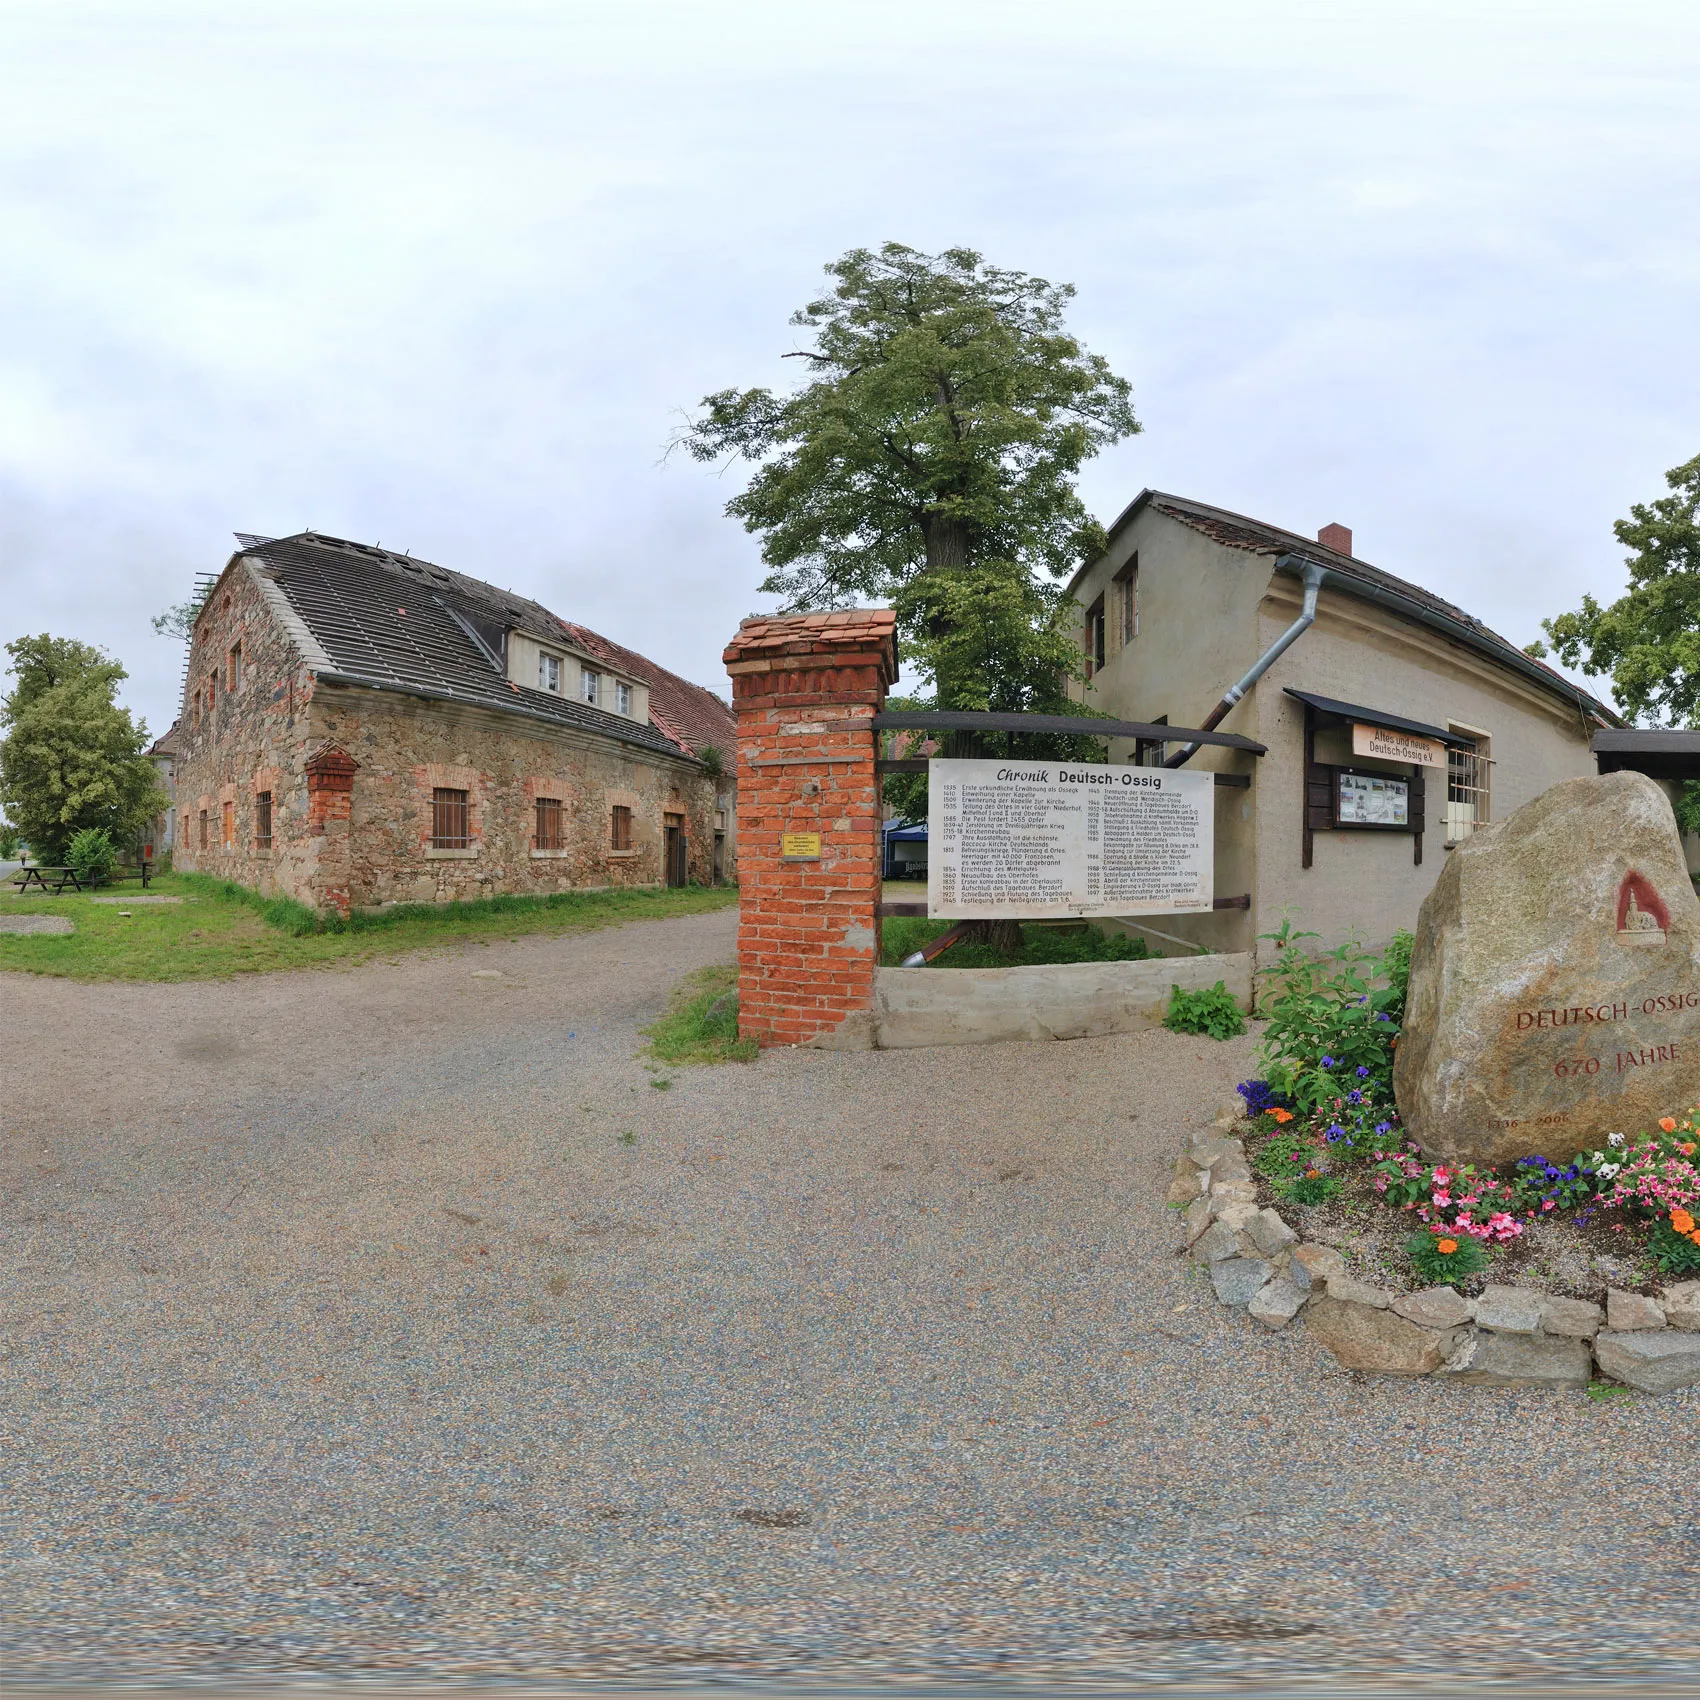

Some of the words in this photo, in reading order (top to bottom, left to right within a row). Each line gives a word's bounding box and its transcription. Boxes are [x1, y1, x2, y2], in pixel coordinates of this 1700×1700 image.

[1374, 730, 1394, 743] Altes
[1396, 736, 1409, 746] und
[1410, 740, 1430, 751] neues
[1370, 741, 1422, 762] Deutsch-Ossig
[1424, 753, 1434, 763] e.V.
[996, 769, 1049, 783] Chronik
[1516, 992, 1700, 1031] DEUTSCH-OSSIG
[1554, 1056, 1600, 1079] 670
[1616, 1042, 1681, 1074] JAHRE
[1534, 1112, 1569, 1126] 2006
